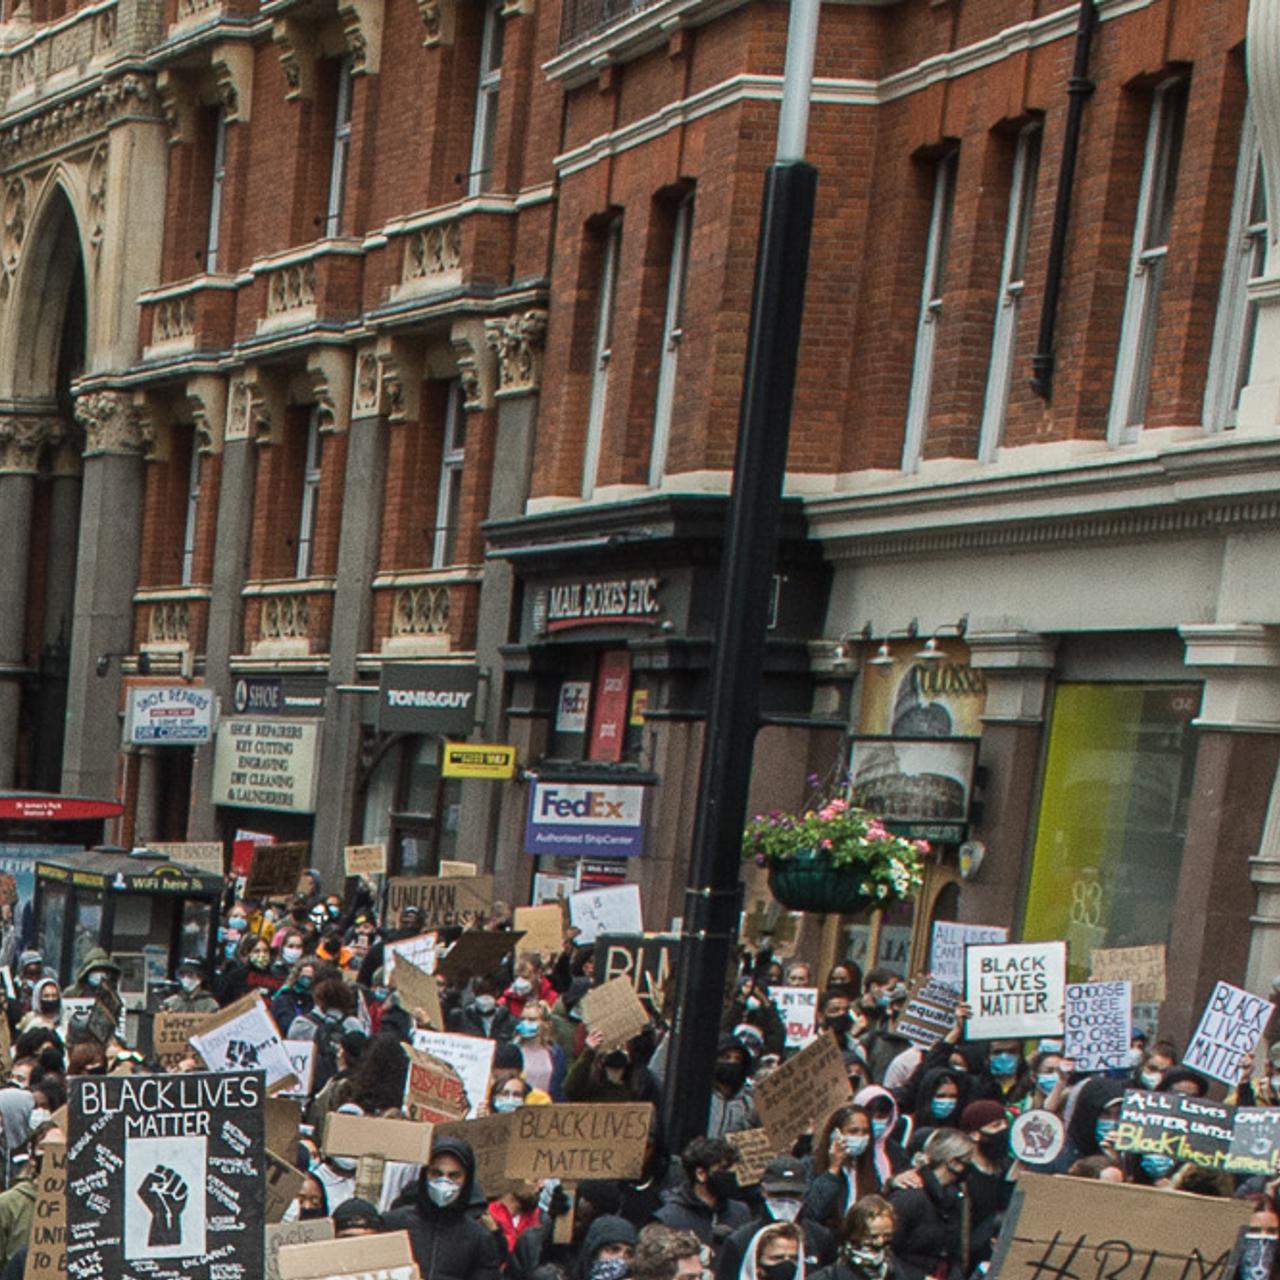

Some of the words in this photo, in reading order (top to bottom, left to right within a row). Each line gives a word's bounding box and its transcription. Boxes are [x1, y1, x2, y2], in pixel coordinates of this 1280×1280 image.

[548, 586, 578, 618] MAIL
[583, 581, 626, 616] BOXES
[249, 685, 277, 707] SHOE
[389, 690, 471, 708] TONI&GUY
[230, 724, 251, 736] SHOE
[256, 725, 302, 738] REPAIRERS
[236, 740, 251, 753] KEY
[255, 740, 293, 754] CUTTING
[239, 757, 287, 771] ENGRAVING
[230, 773, 246, 785] DRY
[250, 774, 293, 788] CLEANING
[541, 790, 623, 818] FedEx
[132, 877, 158, 889] WiFi
[162, 877, 188, 890] here
[391, 883, 457, 909] UNLEARN
[981, 956, 1045, 974] BLACK
[981, 974, 1047, 992] LIVES
[1067, 984, 1125, 1000] CHOOSE
[1067, 1001, 1084, 1015] TO
[1090, 1001, 1120, 1013] SEE
[1215, 985, 1268, 1026] BLACK
[1067, 1014, 1124, 1028] CHOOSE
[1068, 1030, 1085, 1042] TO
[1090, 1028, 1124, 1043] CARE
[1200, 1019, 1259, 1052] LIVES
[1067, 1041, 1125, 1055] CHOOSE
[1095, 1055, 1121, 1067] ACT
[1191, 1039, 1242, 1083] MATTER
[81, 1080, 173, 1116] BLACK
[180, 1076, 258, 1109] LIVES
[124, 1112, 210, 1137] MATTER
[520, 1110, 586, 1141] BLACK
[590, 1110, 647, 1141] LIVES
[533, 1147, 613, 1172] MATTER
